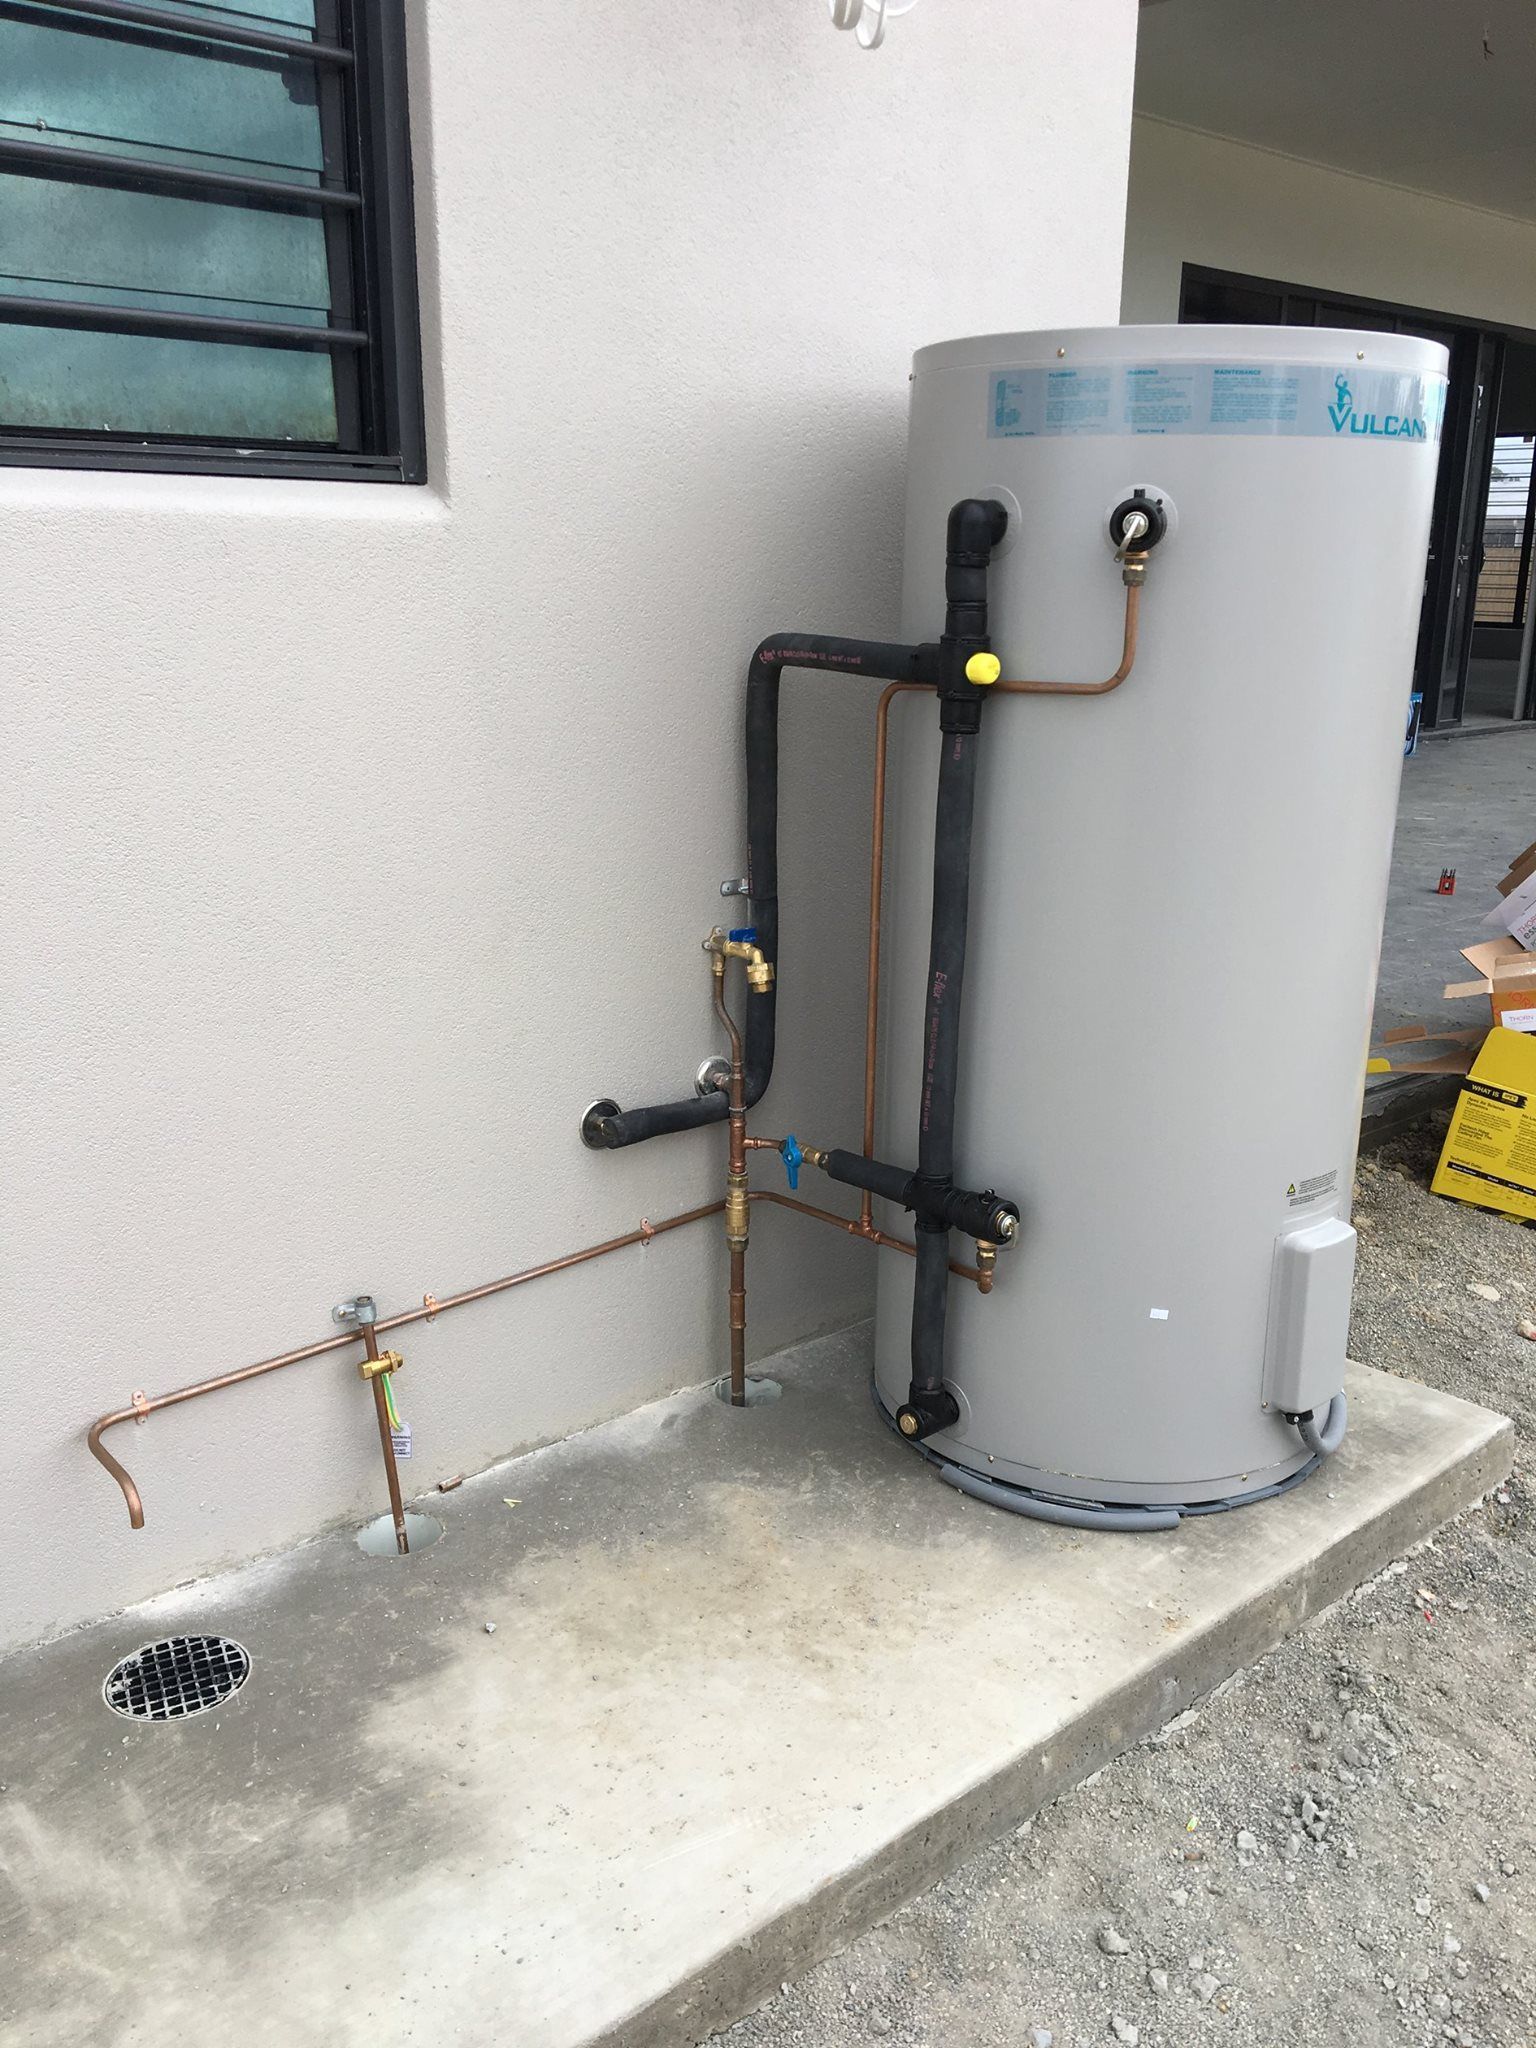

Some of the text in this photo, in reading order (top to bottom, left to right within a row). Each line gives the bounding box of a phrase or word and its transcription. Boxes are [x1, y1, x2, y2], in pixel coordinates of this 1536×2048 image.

[1327, 404, 1427, 439] VULCAN
[1471, 1084, 1491, 1095] WHAT
[1492, 1090, 1500, 1098] IS
